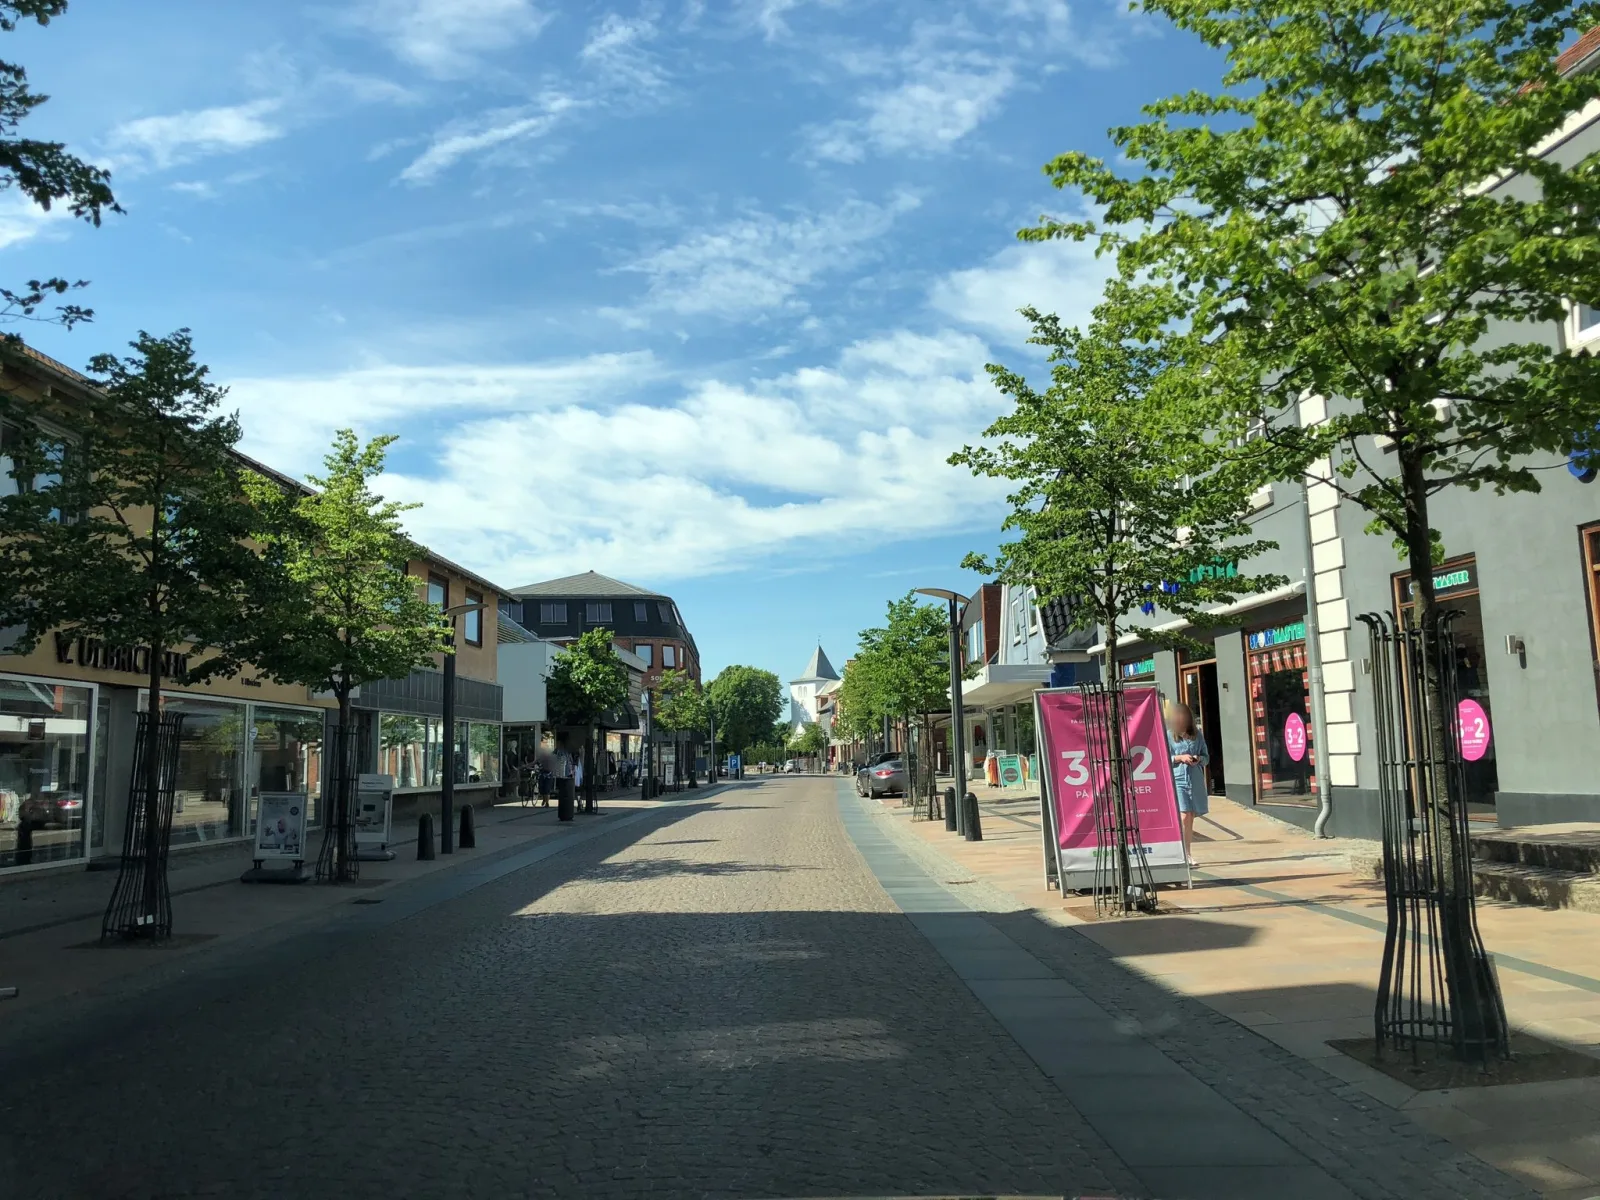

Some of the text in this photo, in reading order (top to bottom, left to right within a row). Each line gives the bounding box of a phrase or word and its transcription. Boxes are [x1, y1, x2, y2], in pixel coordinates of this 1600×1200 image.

[1287, 727, 1303, 745] 3 2
[1474, 717, 1485, 738] 2
[1061, 745, 1157, 786] 3 2
[1076, 788, 1089, 799] PÅ
